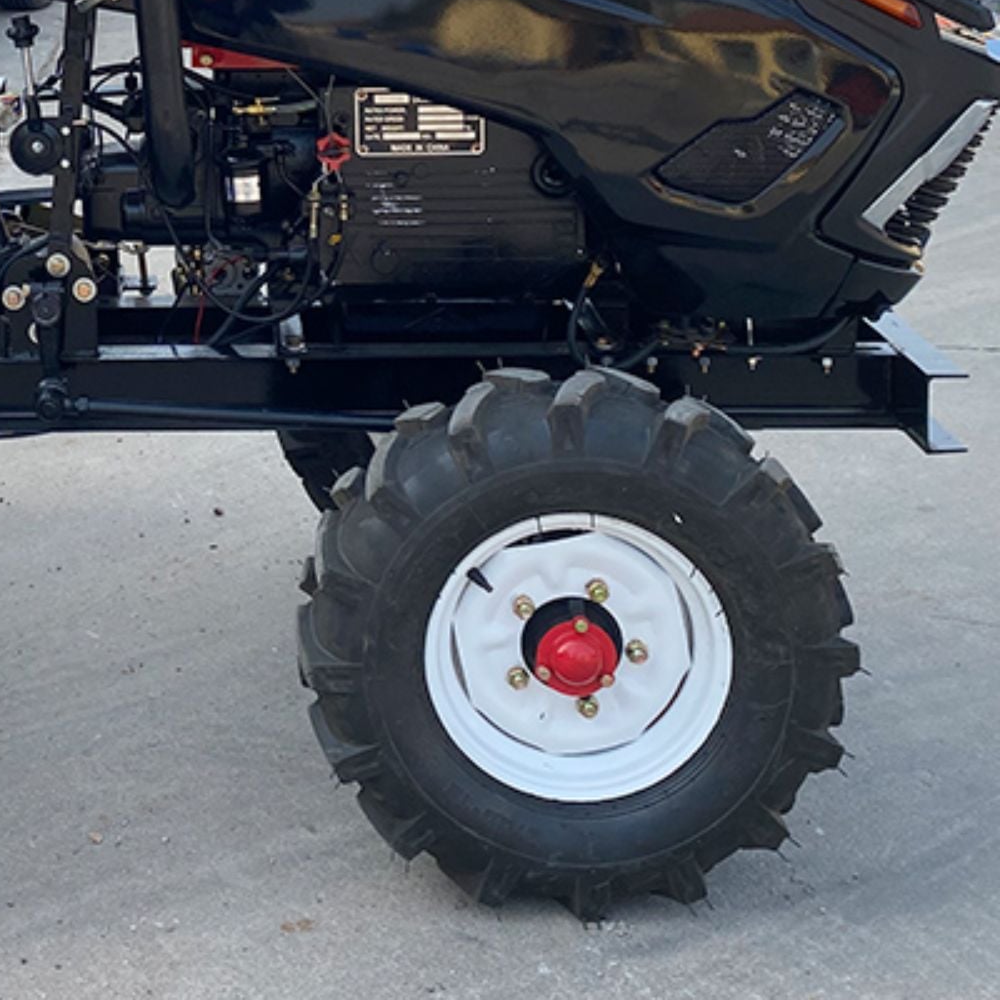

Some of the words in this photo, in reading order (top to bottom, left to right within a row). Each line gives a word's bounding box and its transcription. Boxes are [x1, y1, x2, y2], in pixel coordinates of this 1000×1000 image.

[390, 143, 412, 152] MADE
[415, 143, 423, 152] IN
[427, 143, 450, 152] CHINA
